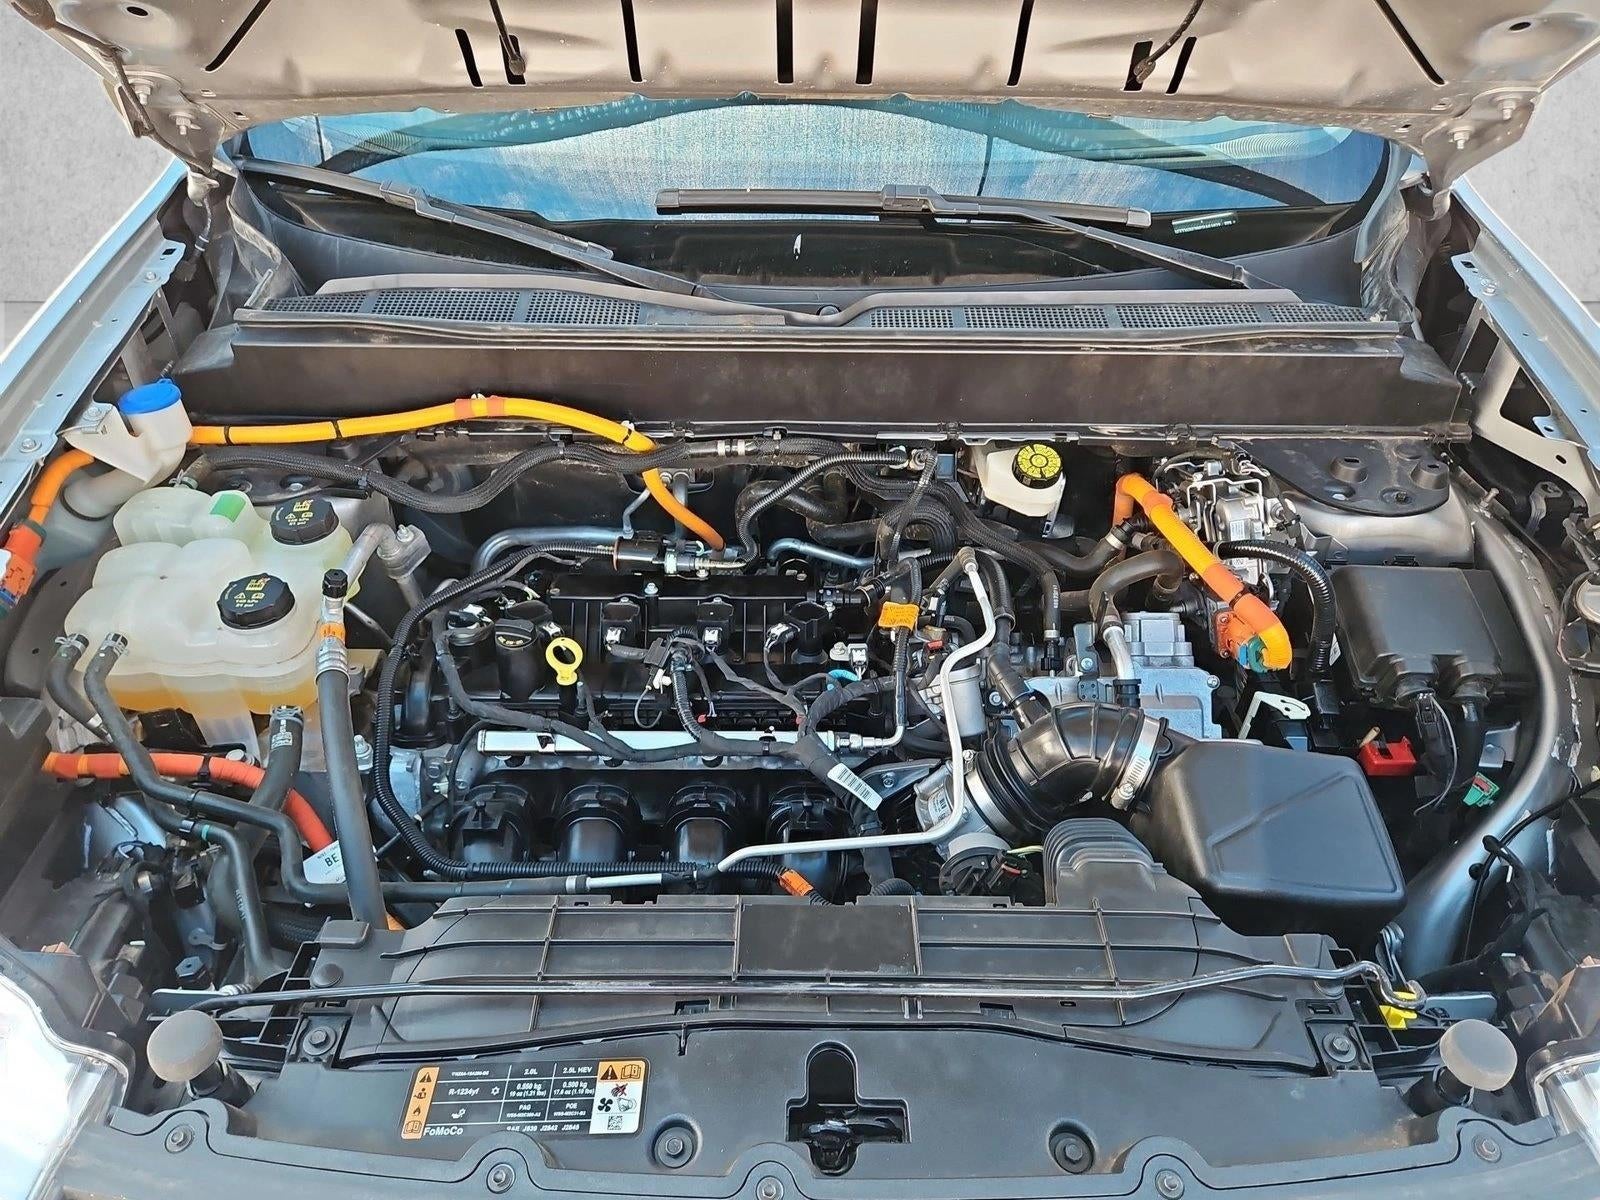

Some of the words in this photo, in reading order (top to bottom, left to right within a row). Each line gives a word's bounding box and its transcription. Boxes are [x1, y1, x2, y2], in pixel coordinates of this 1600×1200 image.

[533, 1082, 542, 1091] kg
[579, 1080, 588, 1089] kg
[423, 1125, 464, 1136] FoMoCo
